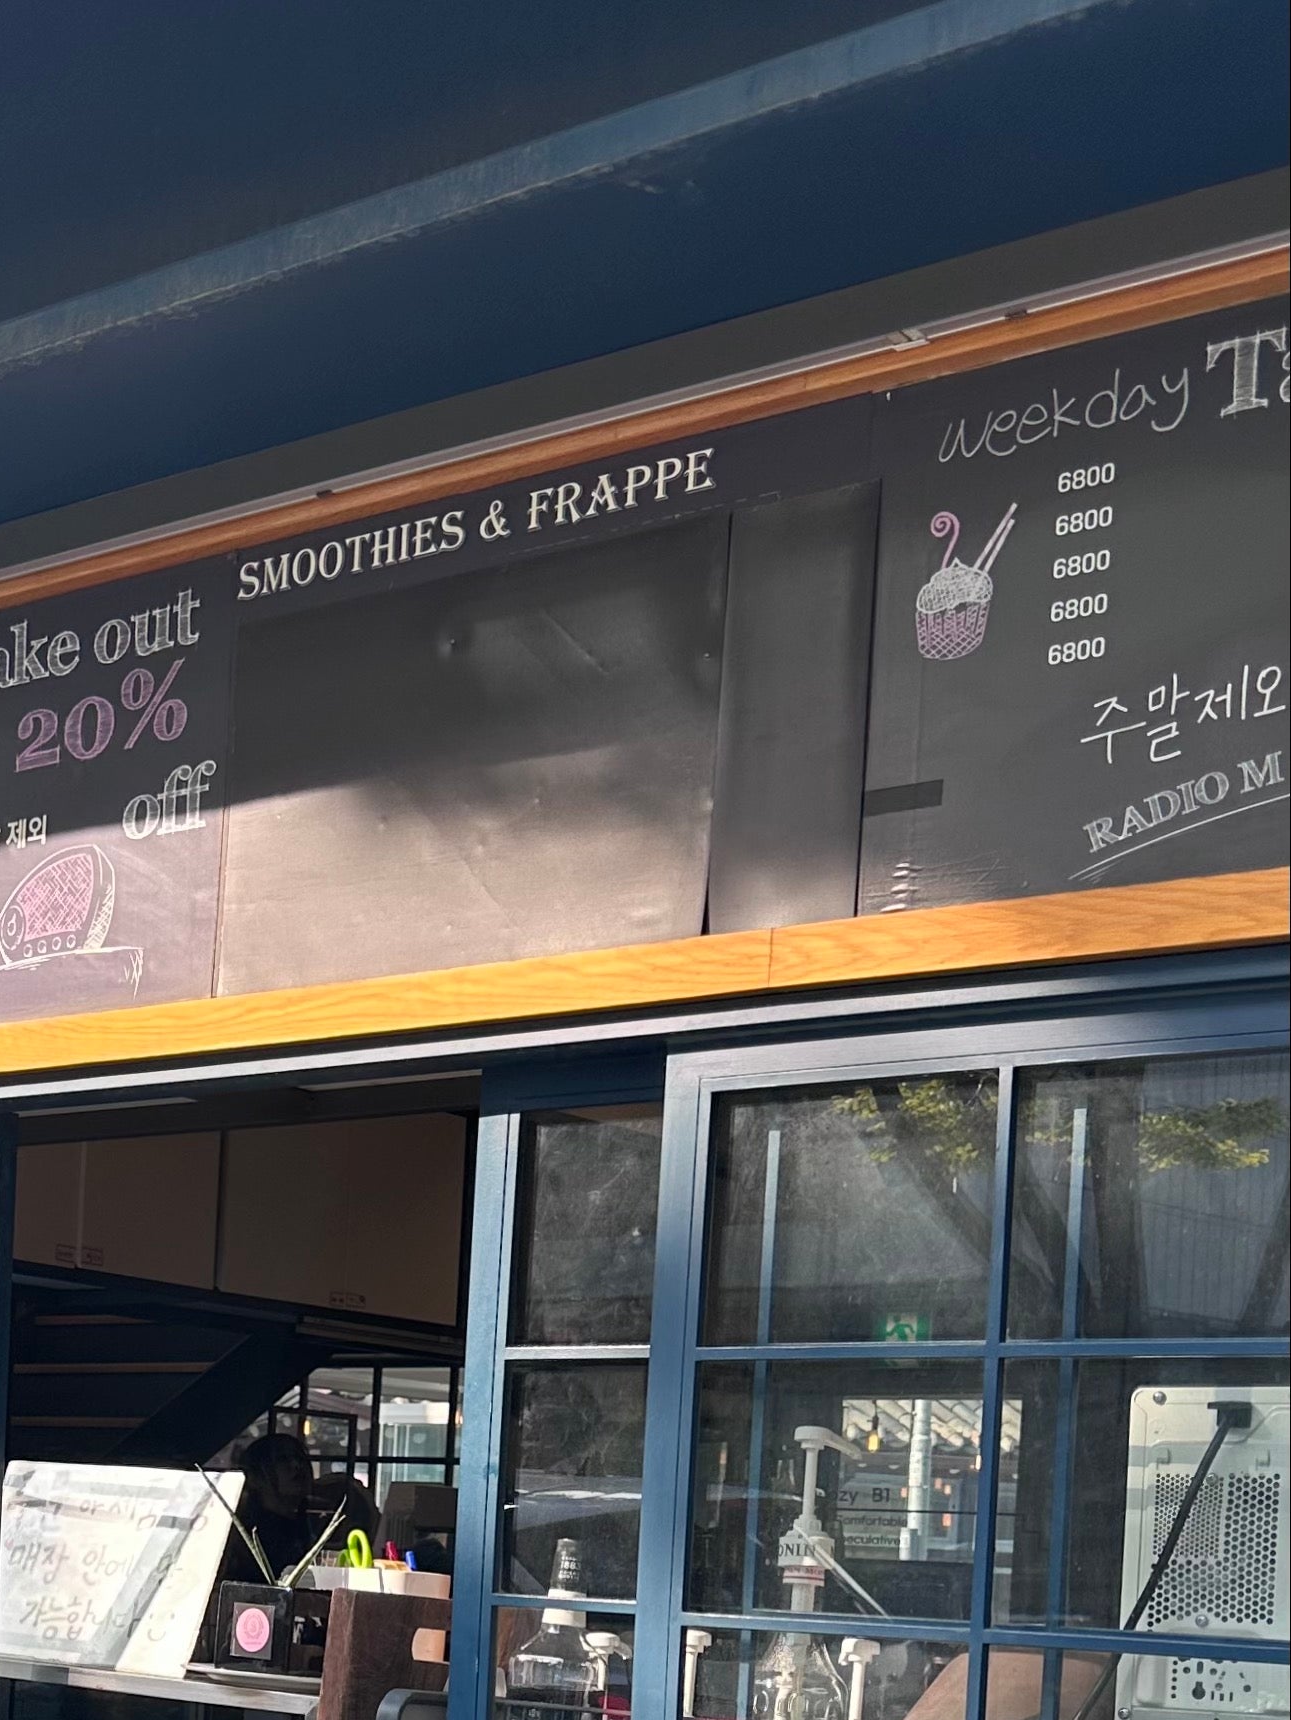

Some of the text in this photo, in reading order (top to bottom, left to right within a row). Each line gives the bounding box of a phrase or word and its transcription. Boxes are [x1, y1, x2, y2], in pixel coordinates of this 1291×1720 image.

[1056, 462, 1116, 494] 6800
[236, 446, 716, 601] SMOOTHIES & FRAPPE
[1054, 505, 1114, 537] 6800
[1051, 548, 1111, 580] 6800
[93, 586, 201, 665] out
[1049, 592, 1109, 623] 6800
[1046, 636, 1106, 666] 6800
[13, 656, 189, 773] 20%
[121, 759, 217, 841] off
[1082, 750, 1286, 854] RADIO M
[5, 814, 48, 850] 제외
